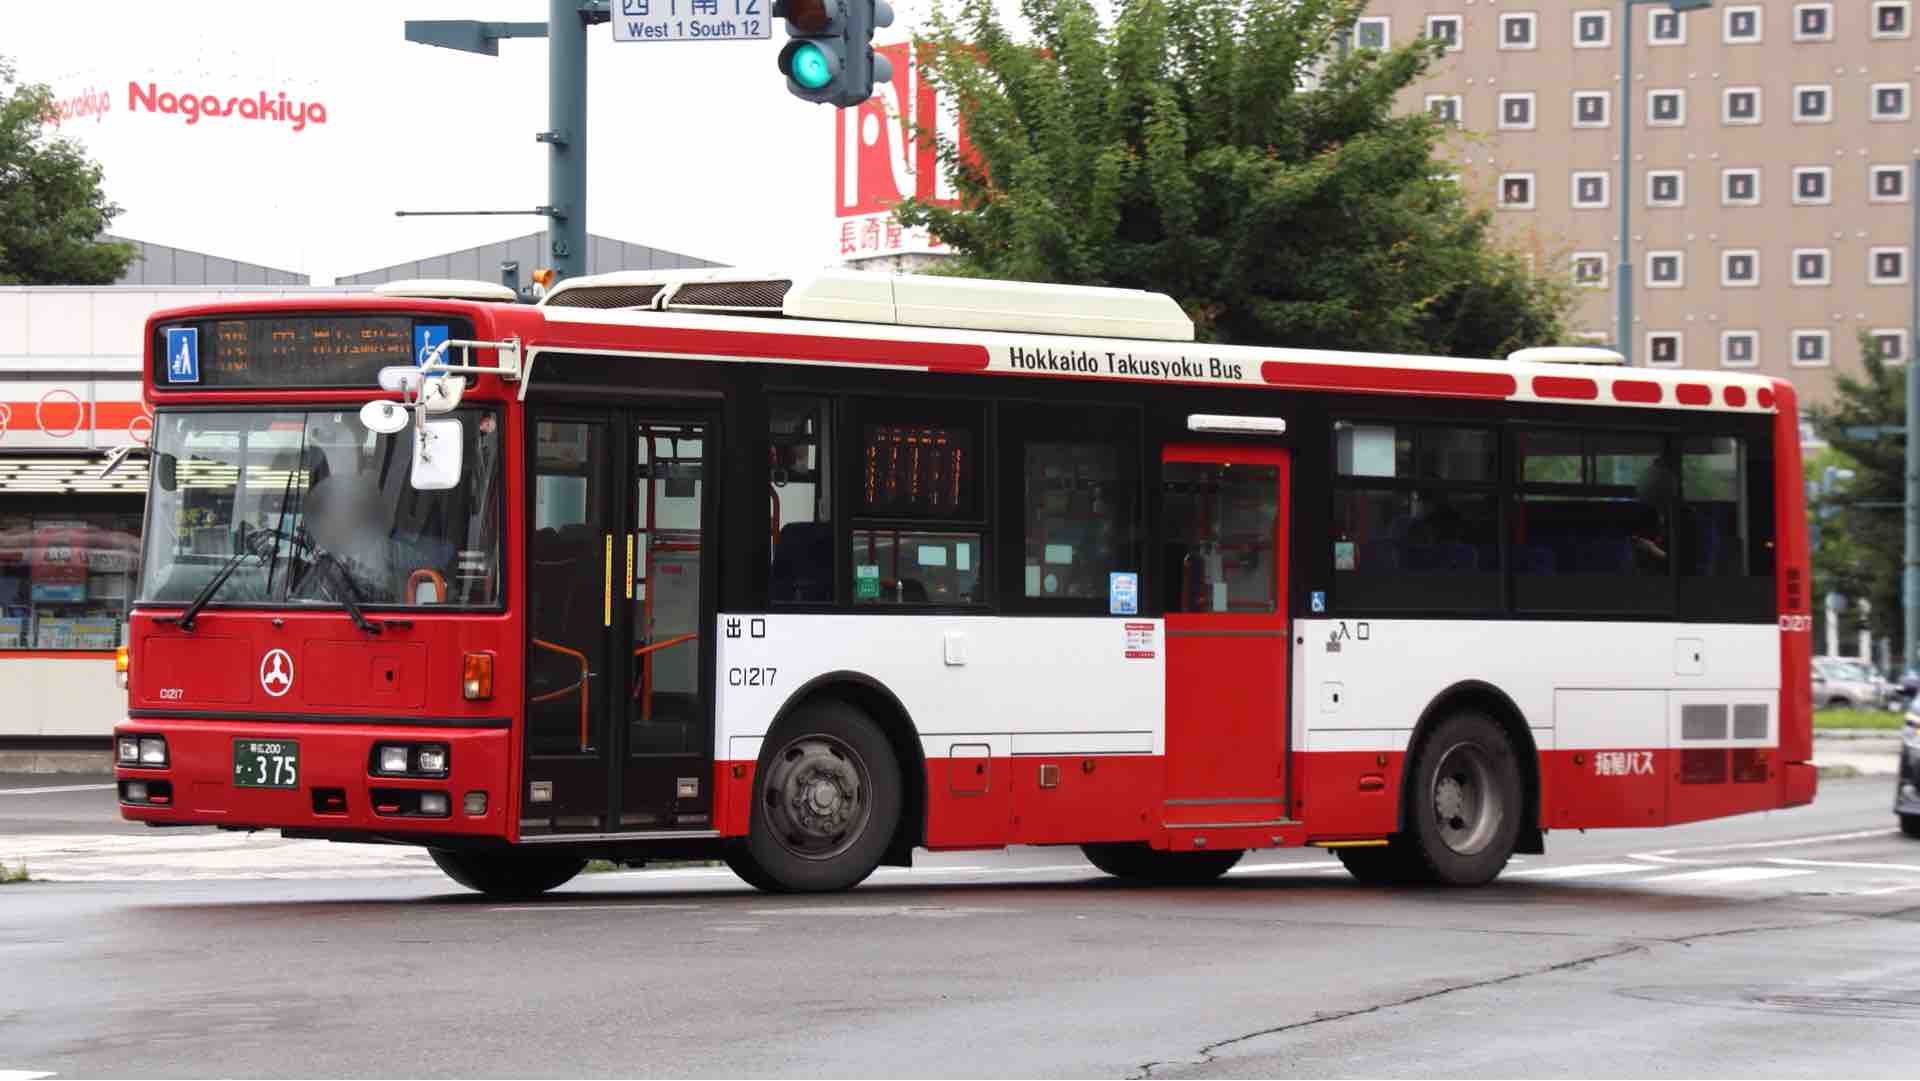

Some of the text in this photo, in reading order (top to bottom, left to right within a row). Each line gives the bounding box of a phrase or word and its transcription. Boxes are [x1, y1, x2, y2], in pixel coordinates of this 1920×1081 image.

[628, 20, 760, 38] West 1 South 12
[128, 81, 327, 132] Nagasakiya
[1010, 346, 1243, 380] Hokkaido Takusyoku Bus
[727, 617, 765, 638] 出口
[1337, 621, 1370, 640] 入口
[729, 667, 777, 686] C1217
[256, 756, 296, 785] 375
